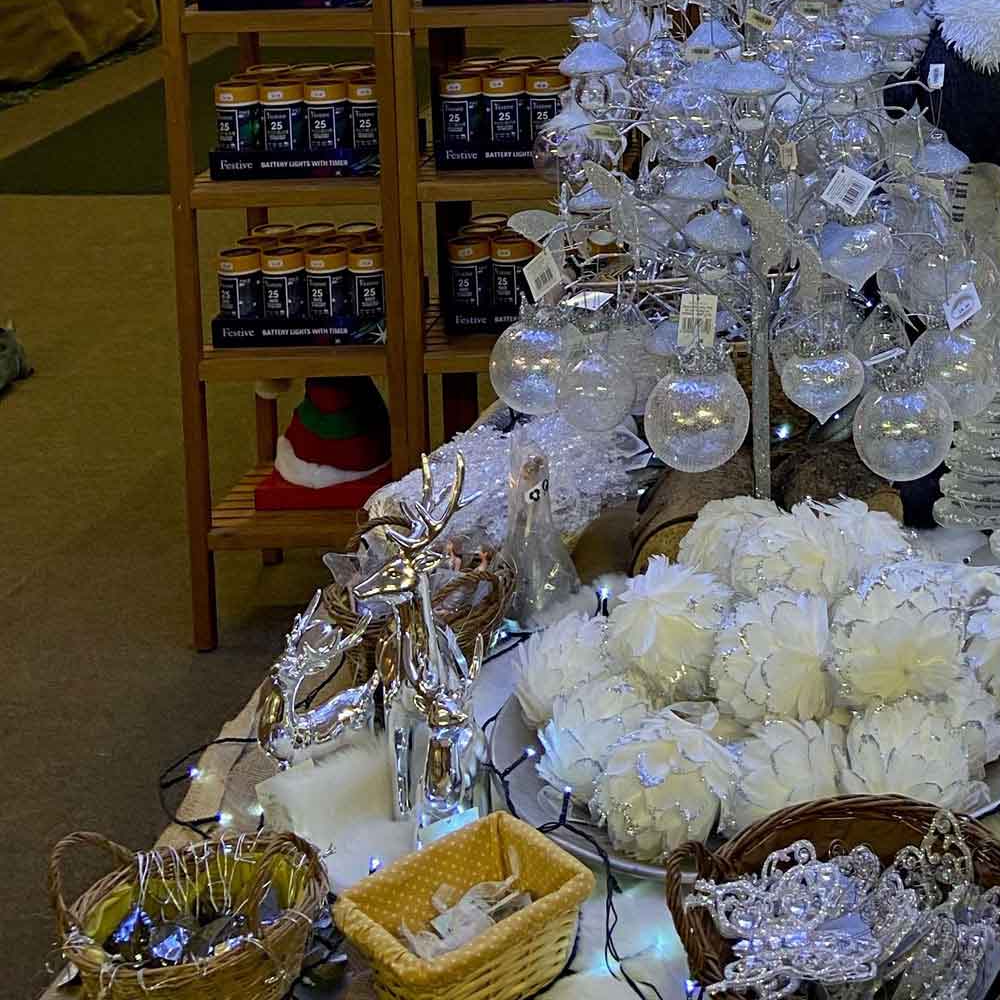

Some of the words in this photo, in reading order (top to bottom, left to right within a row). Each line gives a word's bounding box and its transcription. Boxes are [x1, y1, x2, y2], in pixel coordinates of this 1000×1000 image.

[448, 113, 461, 123] 25
[498, 112, 511, 121] 25
[537, 111, 549, 121] 25
[220, 122, 230, 132] 25
[271, 121, 283, 130] 25
[314, 119, 327, 129] 25
[359, 119, 372, 128] 25
[446, 149, 478, 160] Festive
[485, 151, 512, 159] BATTERY
[220, 159, 253, 170] Festive
[289, 160, 311, 168] LIGHTS
[458, 278, 470, 288] 25
[497, 276, 509, 286] 25
[268, 289, 280, 299] 25
[311, 288, 323, 298] 25
[363, 287, 376, 297] 25
[222, 327, 255, 337] Festive
[290, 328, 311, 336] LIGHTS
